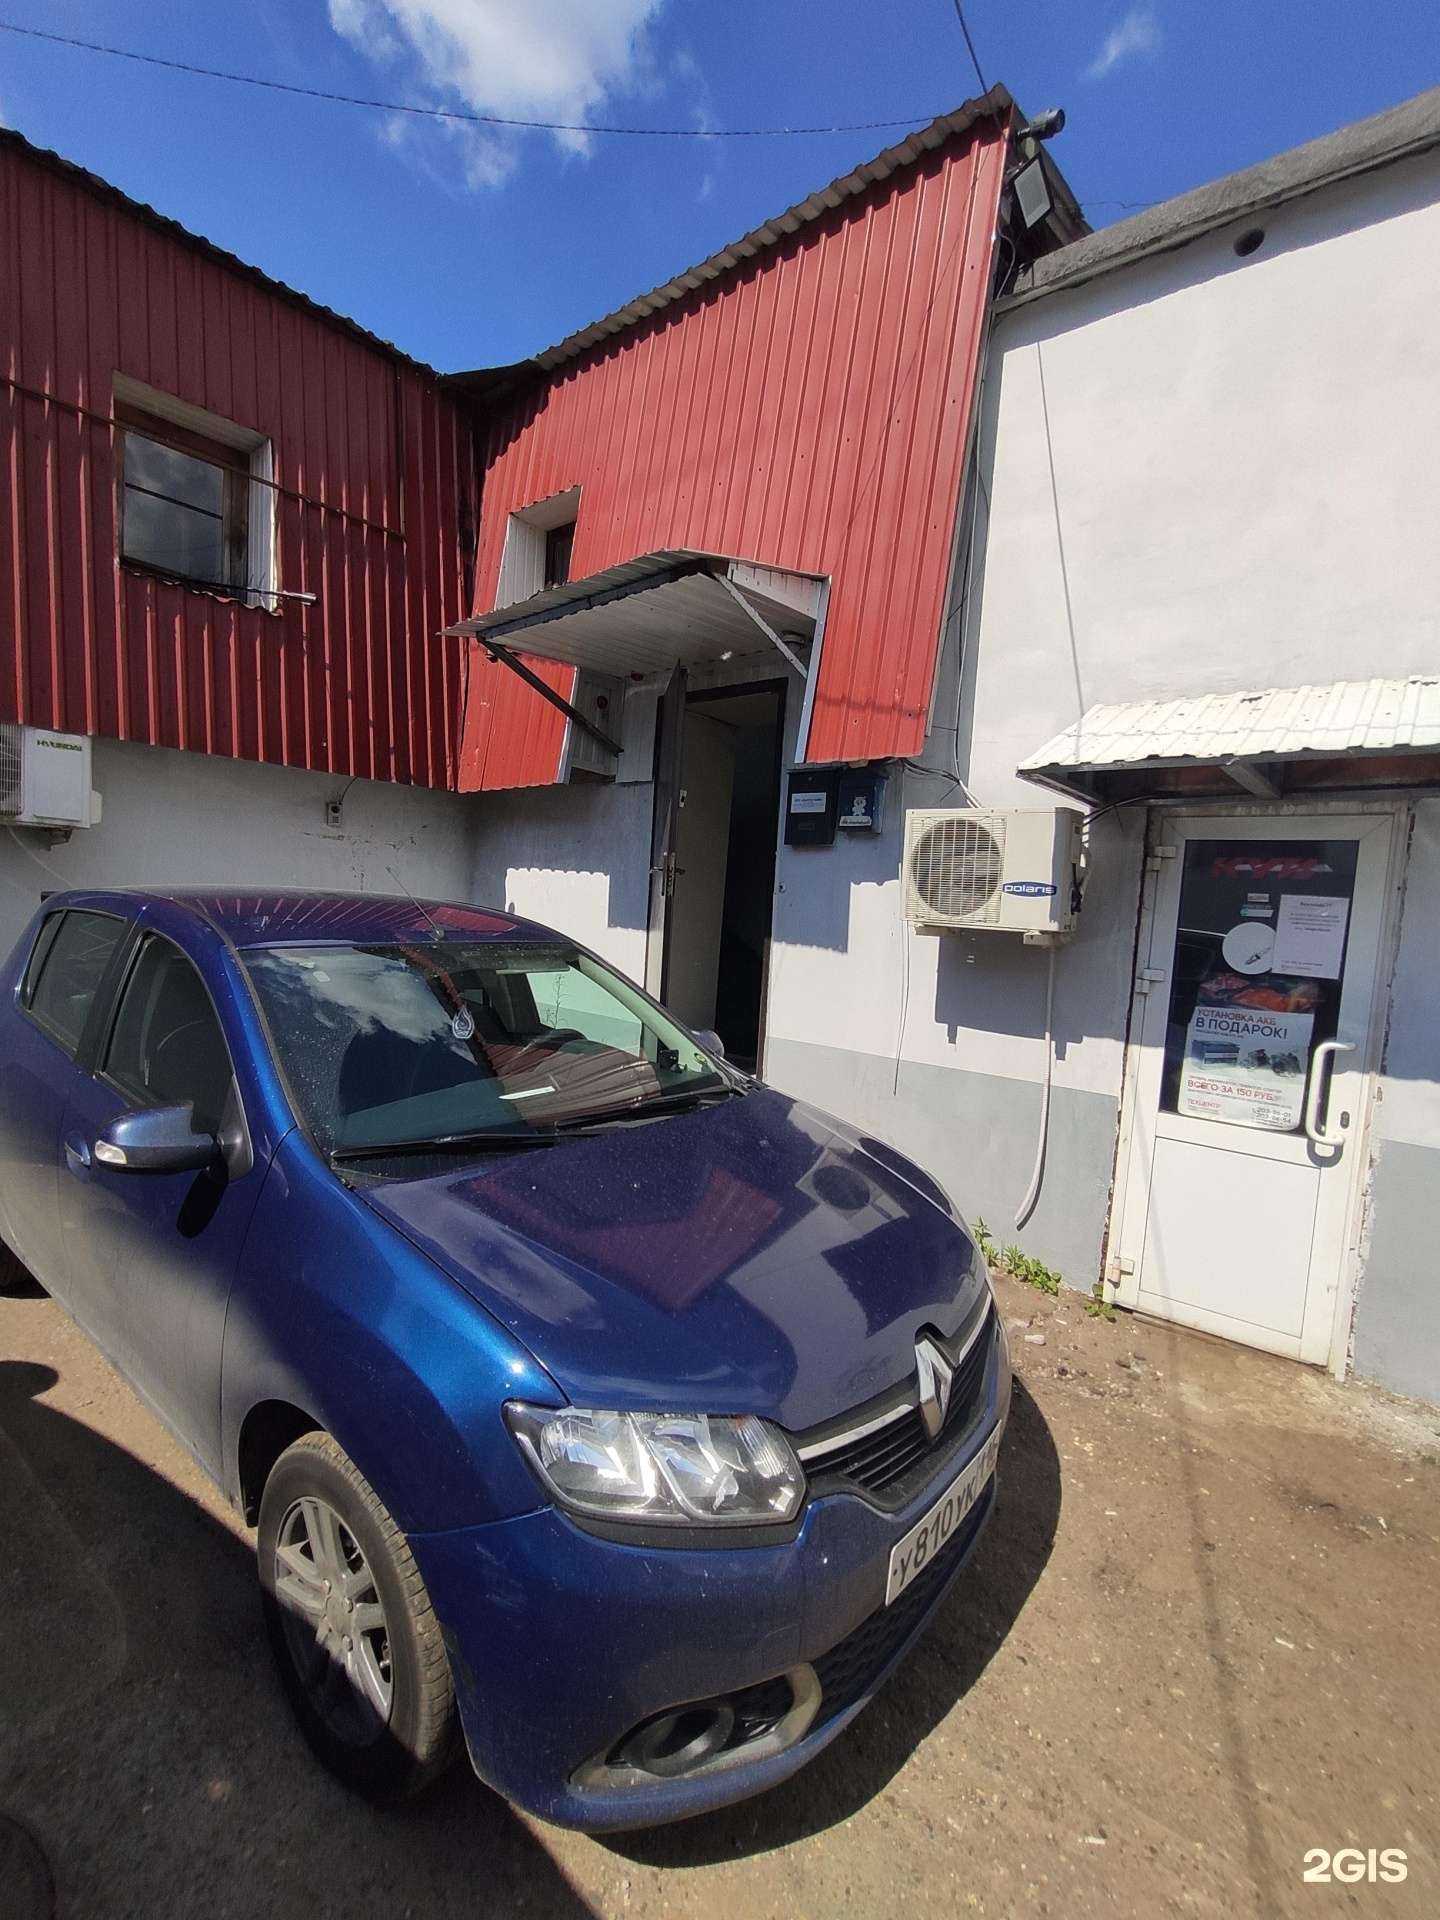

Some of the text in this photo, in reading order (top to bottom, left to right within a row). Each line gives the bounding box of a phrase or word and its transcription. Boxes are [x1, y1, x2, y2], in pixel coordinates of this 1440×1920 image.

[1004, 884, 1055, 894] polaris
[1198, 1009, 1255, 1023] УСТАНОВКА
[1195, 1017, 1205, 1028] В
[1208, 1019, 1288, 1040] ПОДАРОК!
[1187, 1079, 1219, 1091] ВСЕГО
[1221, 1085, 1234, 1095] ЗА
[1236, 1088, 1252, 1097] 150
